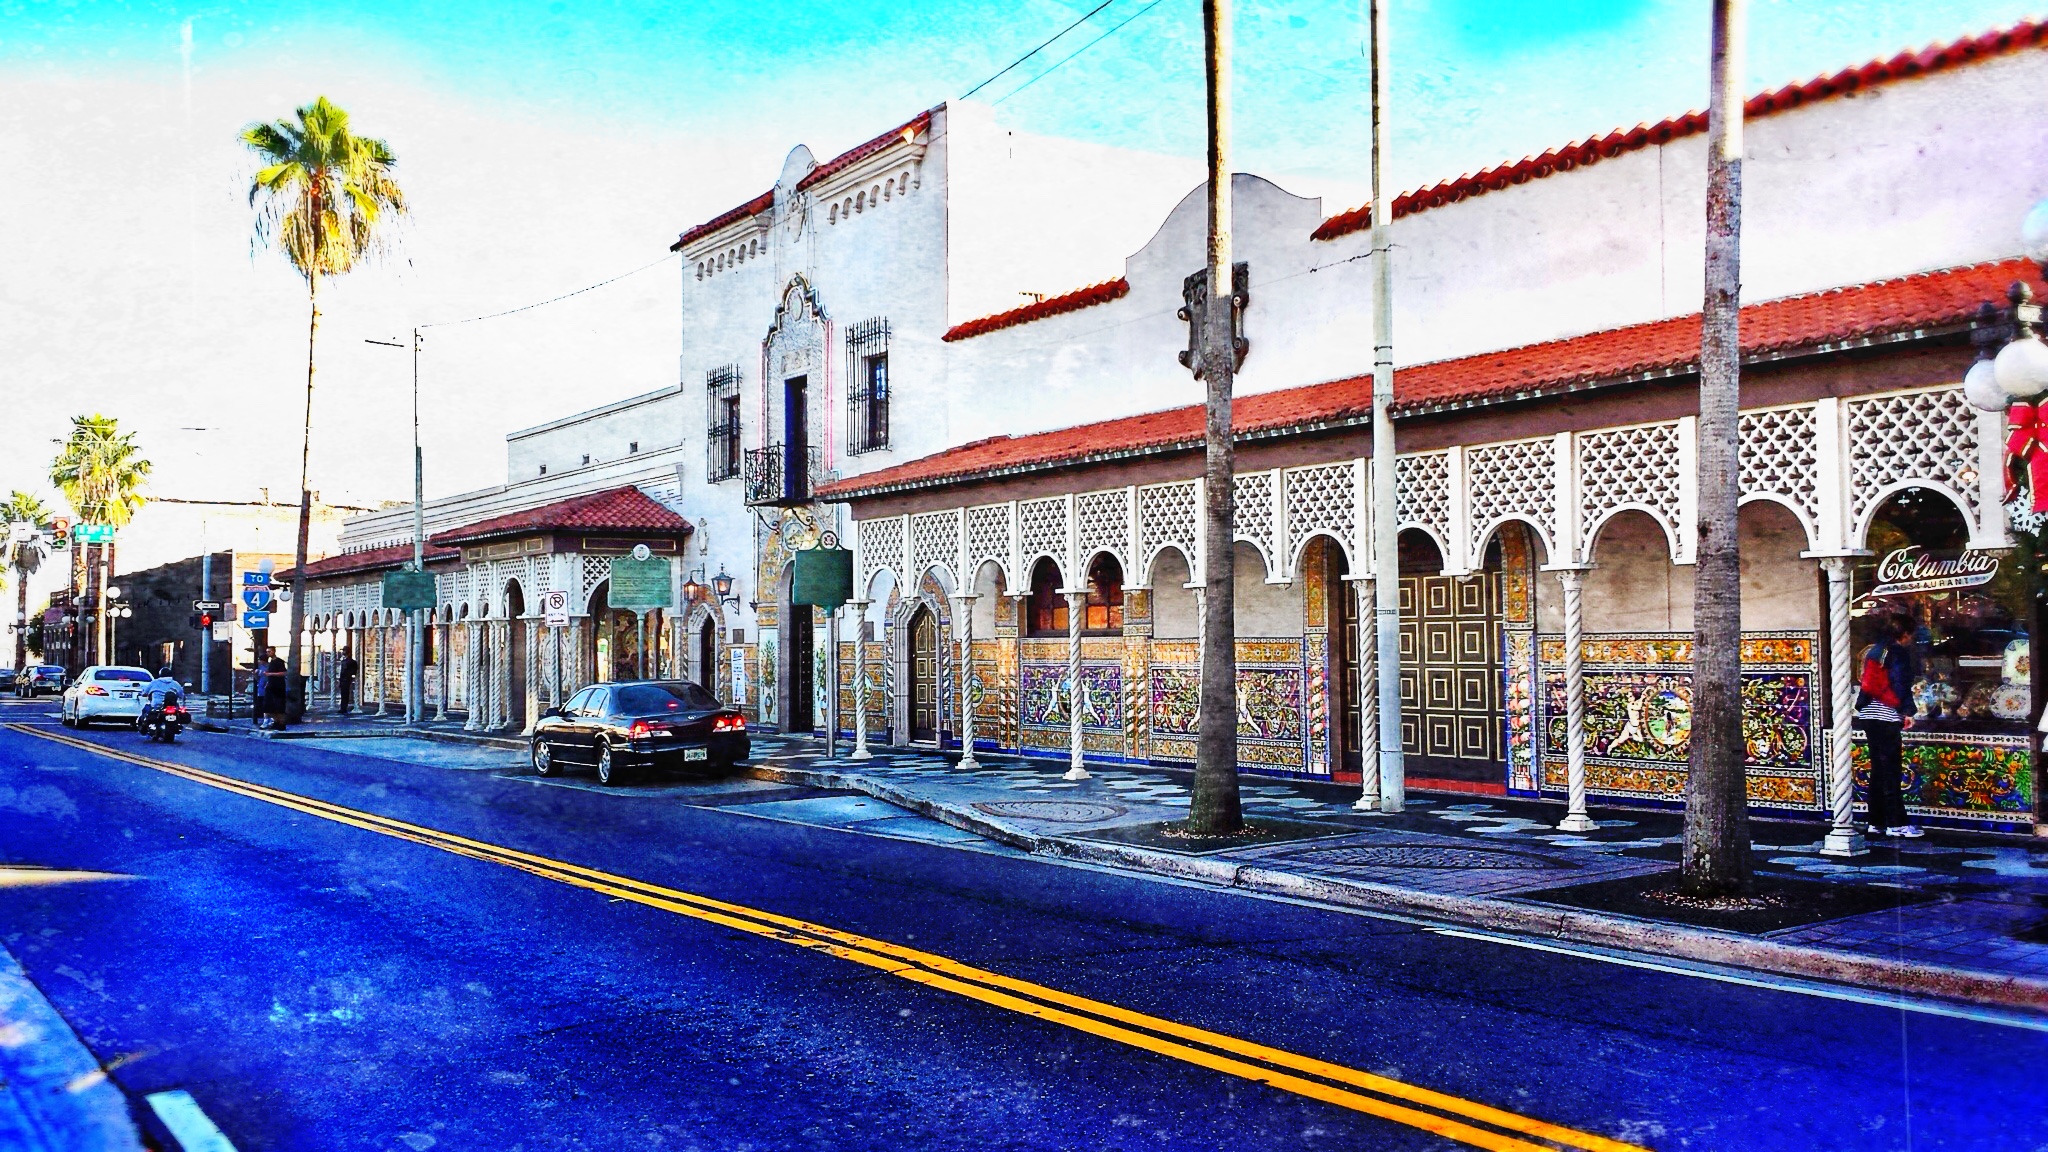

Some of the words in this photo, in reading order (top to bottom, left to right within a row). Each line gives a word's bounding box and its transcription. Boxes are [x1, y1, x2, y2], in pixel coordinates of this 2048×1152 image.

[1878, 546, 1998, 582] Columbia
[250, 575, 264, 583] TO
[250, 592, 261, 607] 4
